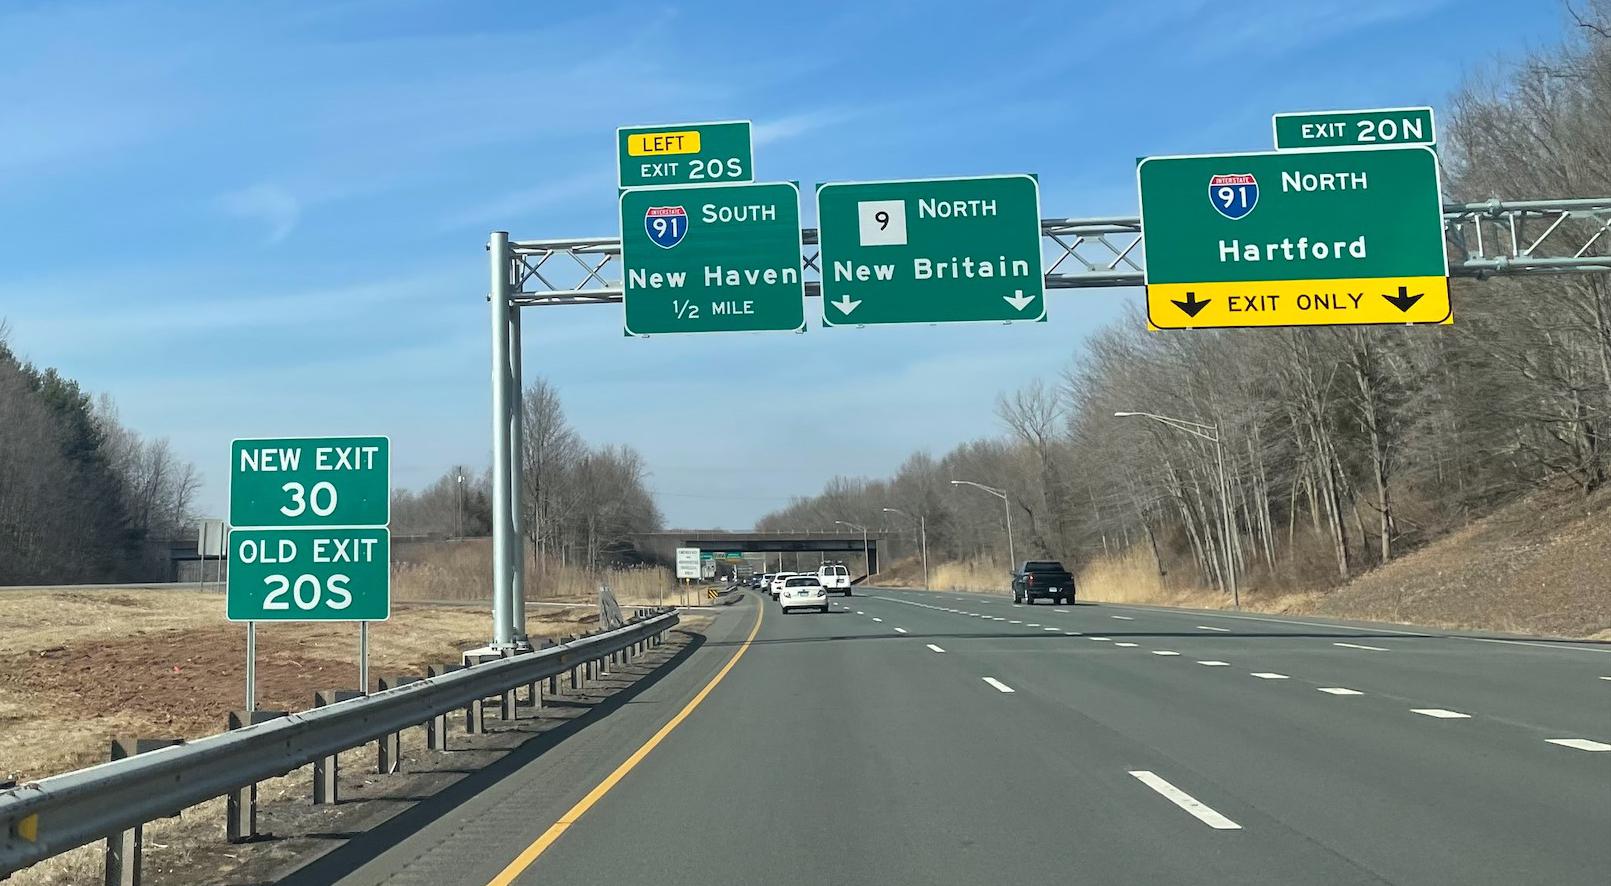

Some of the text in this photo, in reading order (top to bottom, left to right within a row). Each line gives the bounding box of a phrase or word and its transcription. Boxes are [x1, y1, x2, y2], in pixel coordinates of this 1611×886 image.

[1302, 118, 1423, 141] EXIT 20N
[643, 135, 684, 152] LEFT
[640, 157, 742, 179] EXIT 20S
[1281, 171, 1368, 192] NORTH
[919, 198, 997, 218] NORTH
[1218, 186, 1247, 208] 91
[653, 218, 678, 238] 91
[874, 211, 890, 231] 9
[1218, 235, 1367, 262] Hartford
[628, 264, 798, 290] New Haven
[834, 256, 1030, 282] New Britain
[712, 300, 755, 316] MILE
[1228, 292, 1364, 312] EXIT ONLY
[240, 446, 379, 472] NEW EXIT
[279, 481, 338, 517] 30
[239, 538, 378, 564] OLD EXIT
[262, 573, 353, 611] 20S
